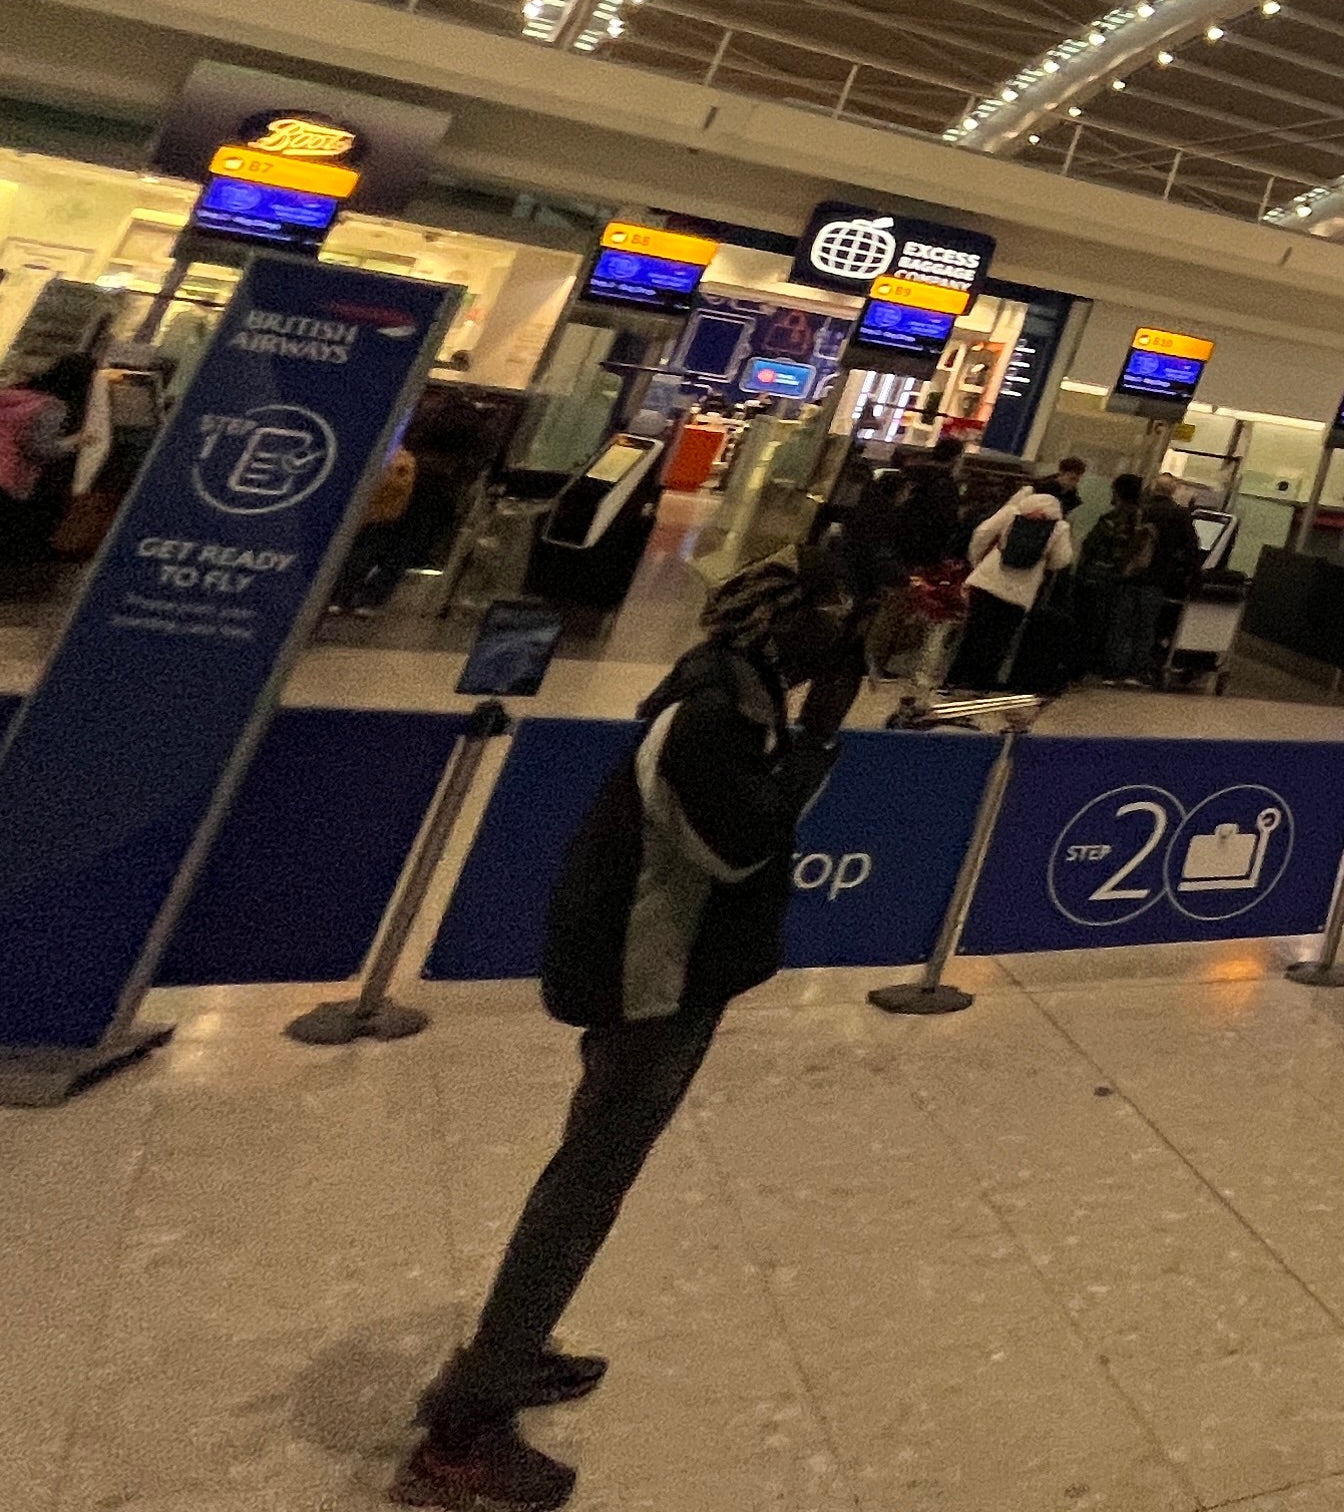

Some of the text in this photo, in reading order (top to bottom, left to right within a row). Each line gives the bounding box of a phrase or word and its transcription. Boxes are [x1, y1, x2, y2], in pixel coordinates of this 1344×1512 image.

[248, 119, 357, 156] Boots
[898, 256, 976, 281] BAGGAGE
[902, 241, 980, 268] EXCESS
[247, 309, 359, 343] BRITISH
[229, 332, 348, 363] AIRWAYS
[138, 538, 297, 571] GET READY
[161, 565, 199, 587] TO
[1066, 801, 1168, 900] STEP 2
